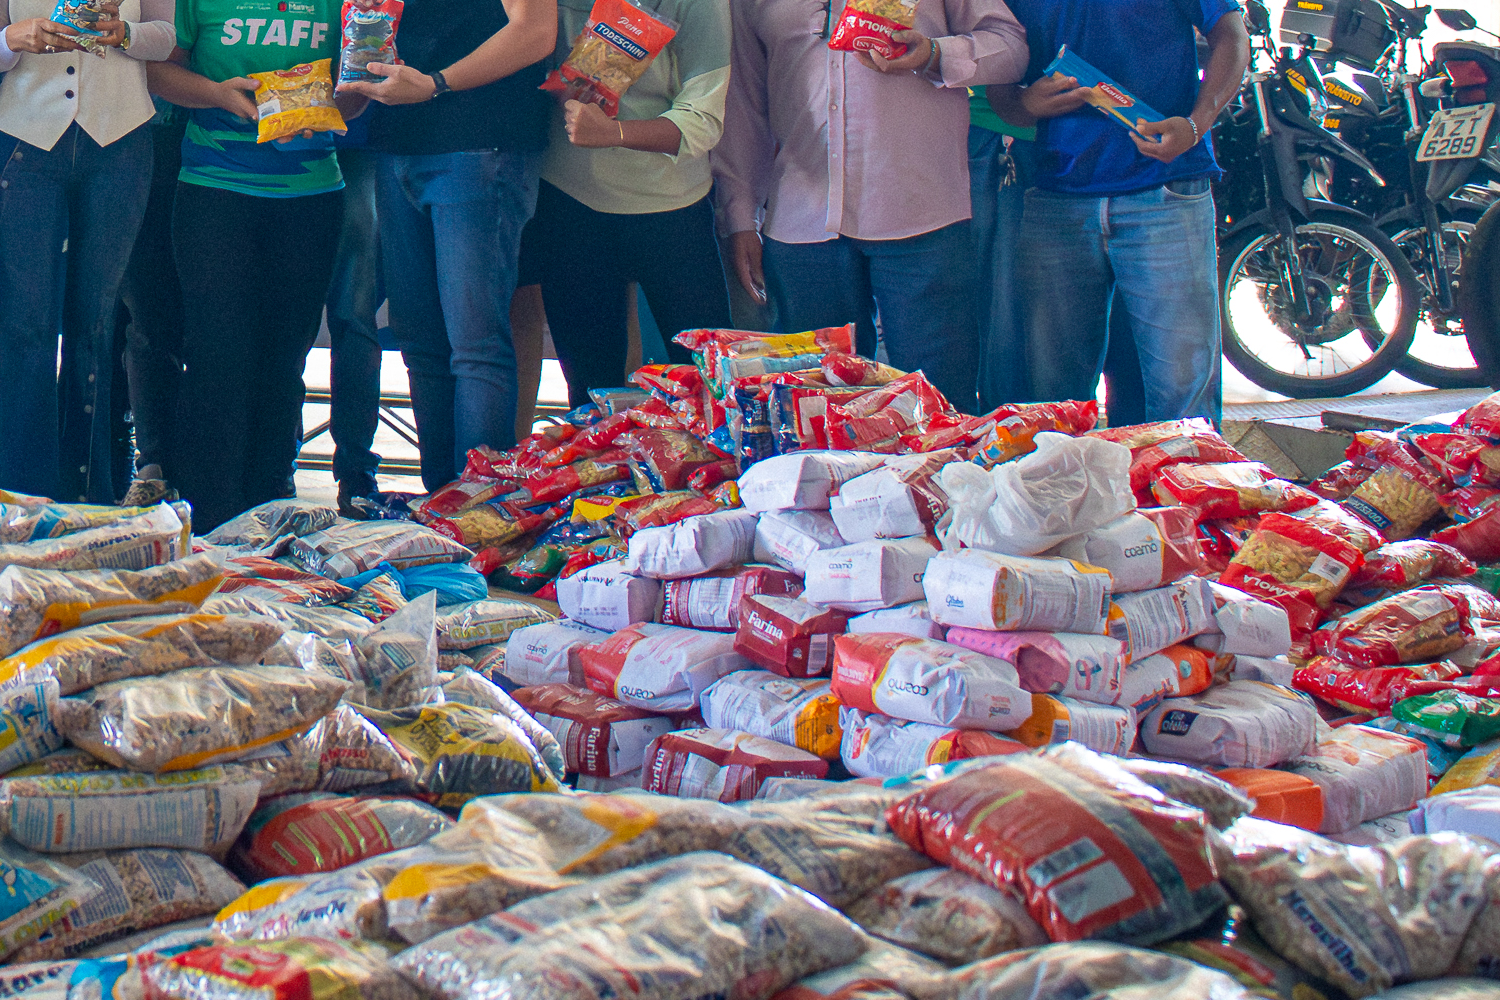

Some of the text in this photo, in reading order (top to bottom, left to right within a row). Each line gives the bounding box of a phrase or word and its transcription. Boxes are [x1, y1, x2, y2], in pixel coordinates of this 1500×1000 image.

[617, 11, 643, 31] Pena
[221, 18, 328, 49] STAFF
[597, 24, 646, 58] TODESCHINI
[1101, 84, 1128, 105] Barilla
[1433, 117, 1483, 138] AZT
[1424, 136, 1477, 157] 6289
[1124, 543, 1158, 558] coamo
[828, 562, 853, 570] coamo
[747, 610, 784, 640] Farina
[620, 686, 655, 700] coamo
[888, 678, 929, 696] coamo
[587, 727, 601, 772] Farina
[649, 748, 666, 794] Farina
